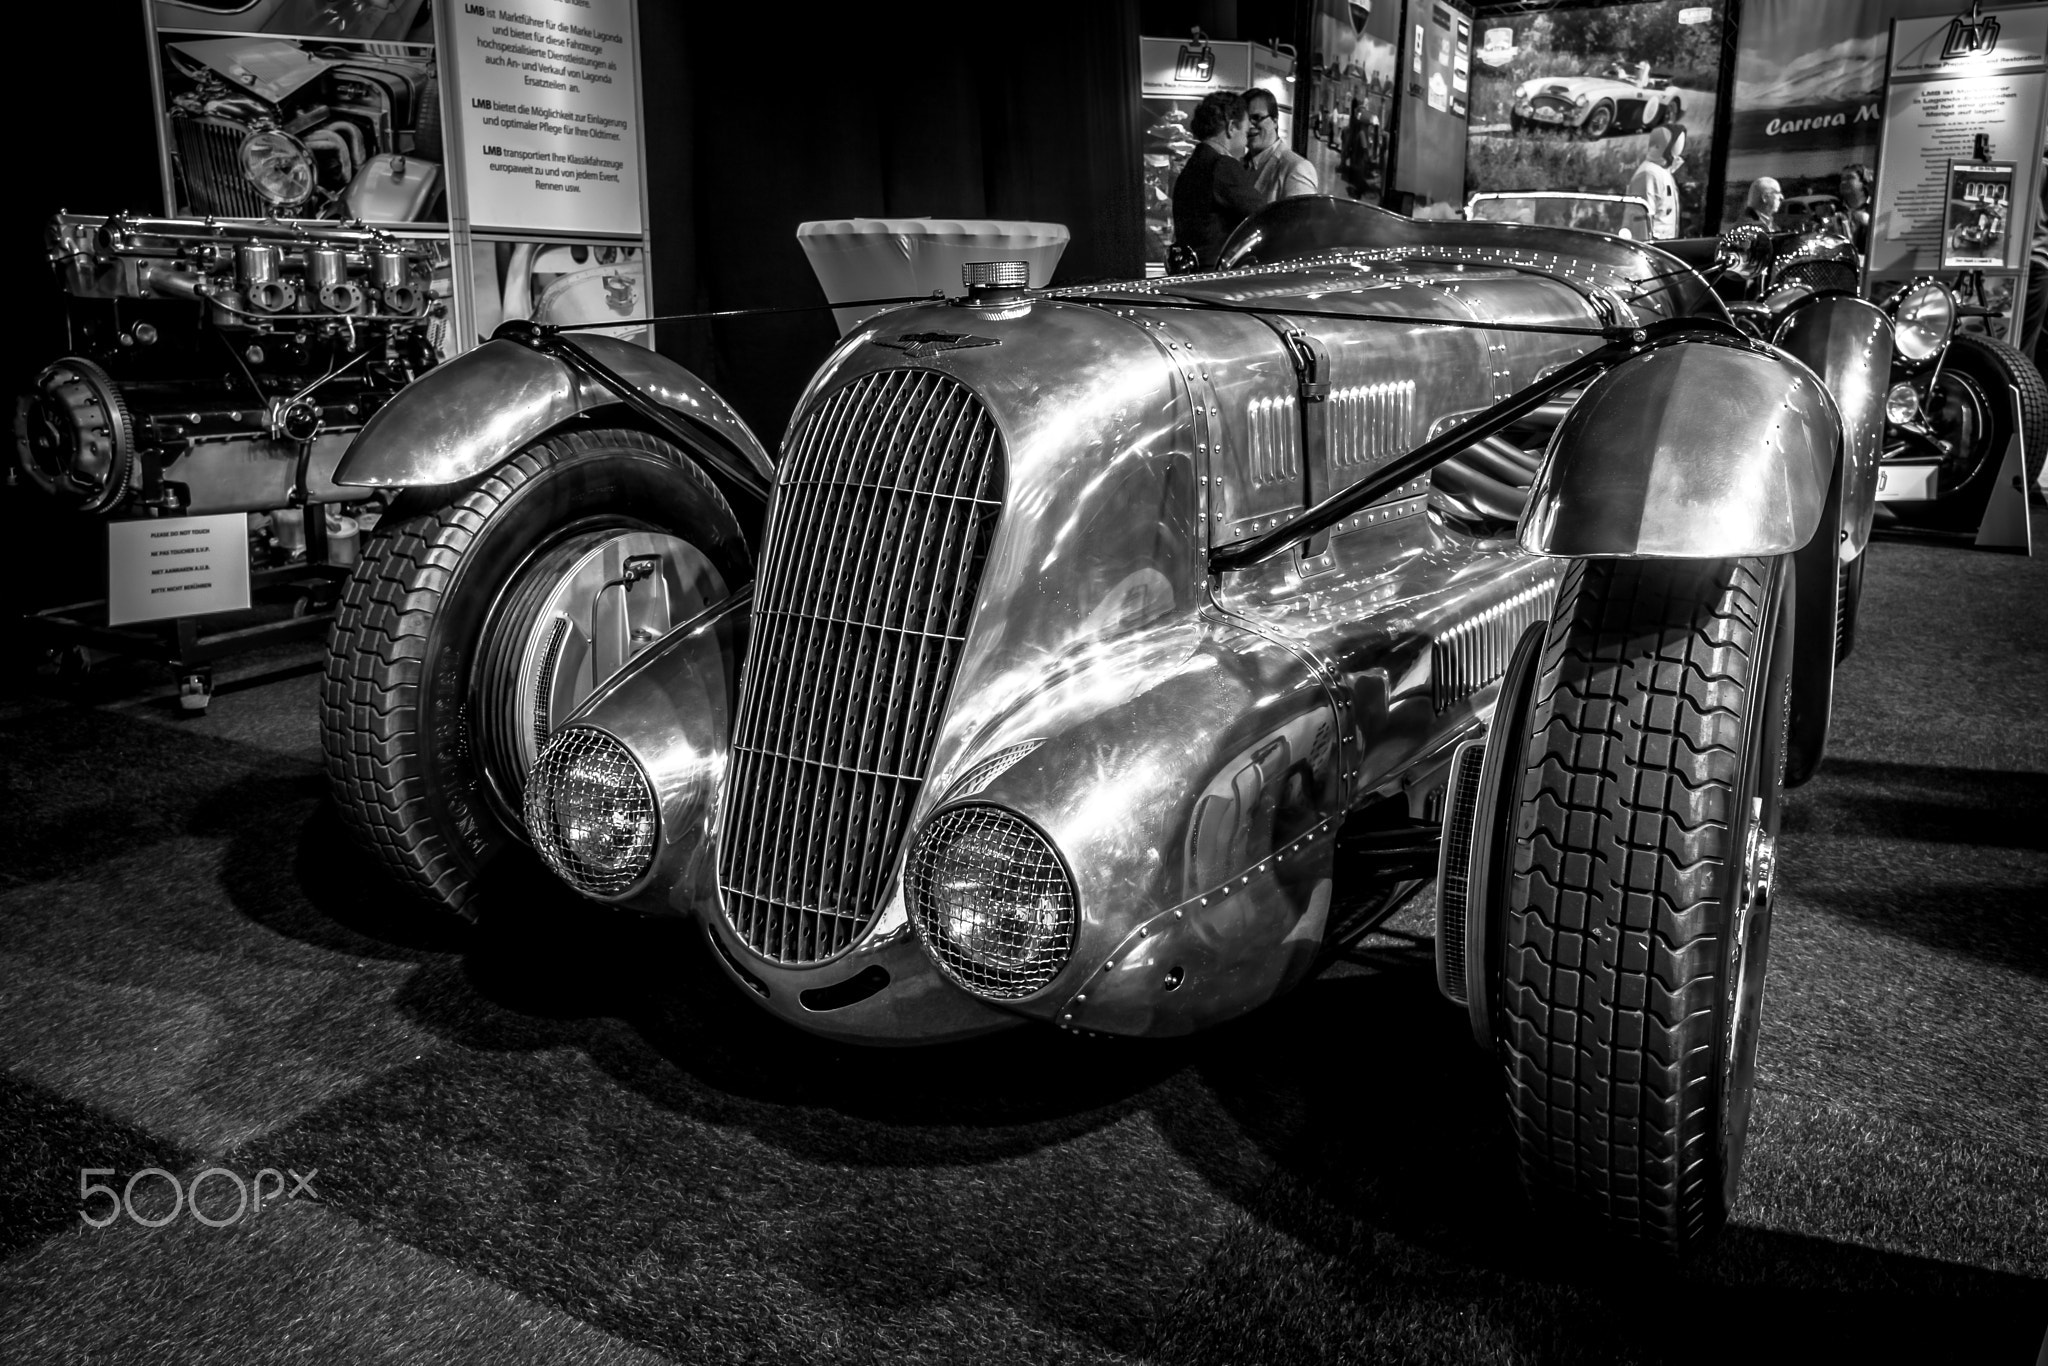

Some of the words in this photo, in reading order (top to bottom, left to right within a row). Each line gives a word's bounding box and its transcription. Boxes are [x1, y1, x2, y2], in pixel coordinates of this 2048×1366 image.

[465, 3, 485, 16] LMB
[486, 7, 496, 19] ist
[499, 9, 544, 28] Marktführer
[545, 19, 556, 30] für
[557, 22, 569, 33] die
[570, 24, 592, 38] Marke
[593, 28, 623, 44] Lagonda
[492, 26, 508, 36] und
[510, 27, 533, 41] bietet
[534, 31, 545, 43] für
[546, 35, 565, 47] diese
[566, 38, 603, 55] Fahrzeuge
[477, 36, 546, 58] hochspezialisierte
[547, 49, 607, 70] Dienstleistungen
[608, 60, 617, 71] als
[2000, 54, 2042, 62] Restoration
[485, 55, 505, 67] auch
[506, 57, 521, 68] An-
[522, 61, 537, 71] und
[537, 62, 566, 76] Verkauf
[567, 69, 581, 79] von
[582, 70, 612, 84] Lagonda
[524, 75, 566, 92] Ersatzteilen
[569, 84, 580, 94] an.
[1923, 96, 1960, 104] Lagonda
[472, 98, 492, 110] LMB
[493, 101, 516, 113] bietet
[517, 104, 529, 115] die
[531, 106, 573, 120] Möglichkeit
[575, 113, 586, 122] zur
[587, 113, 628, 131] Einlagerung
[1765, 112, 1845, 136] Carrera
[483, 116, 499, 126] und
[501, 119, 537, 131] optimaler
[539, 121, 562, 136] Pflege
[563, 124, 573, 135] für
[575, 126, 588, 137] Ihre
[589, 128, 621, 141] Oldtimer.
[483, 145, 502, 156] LMB
[503, 148, 550, 161] transportiert
[552, 152, 566, 163] Ihre
[567, 154, 623, 171] Klassikfahrzeuge
[489, 163, 533, 174] europaweit
[535, 167, 544, 175] zu
[545, 167, 559, 177] und
[561, 170, 575, 178] von
[576, 169, 598, 181] jedem
[599, 171, 620, 183] Event,
[535, 180, 563, 191] Rennen
[565, 184, 581, 193] usw.
[170, 547, 194, 555] TOUCHER
[183, 582, 212, 590] BERÜHREN
